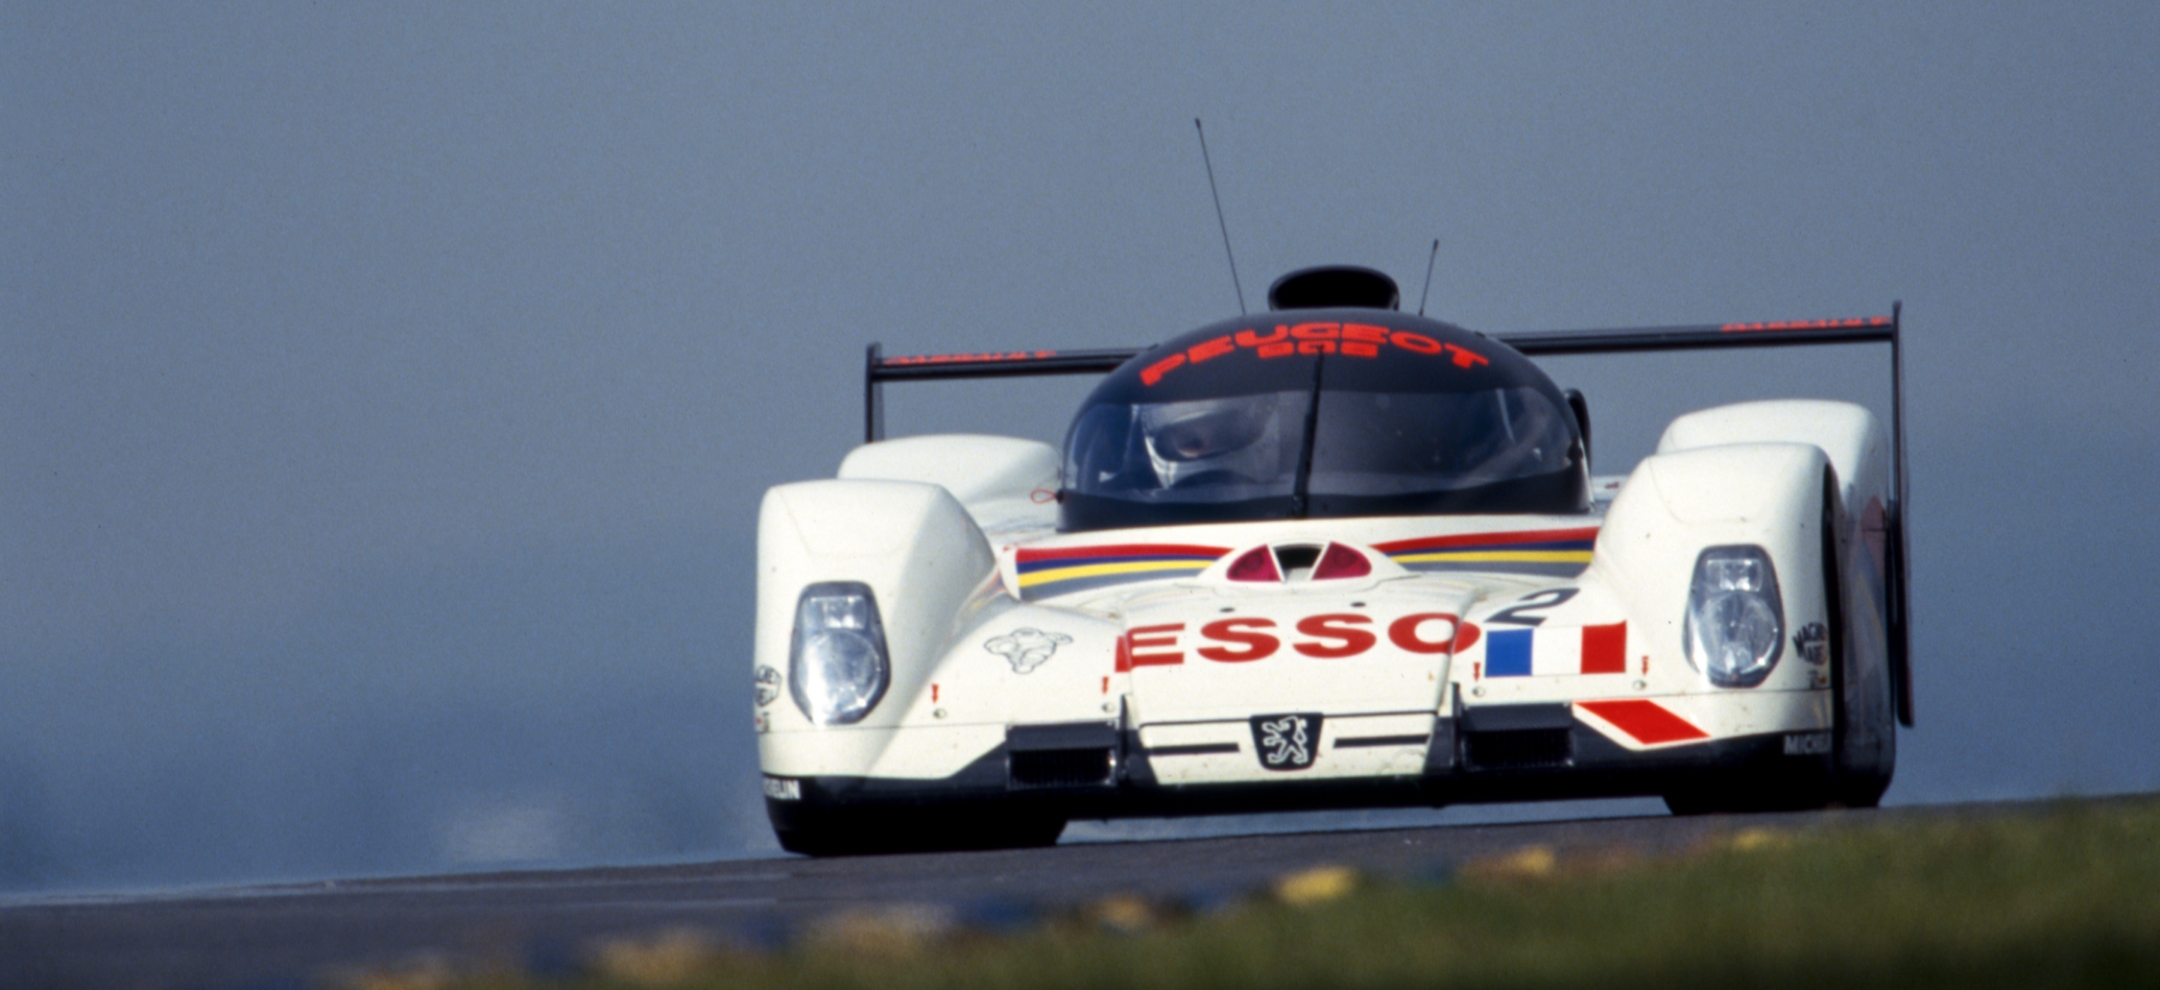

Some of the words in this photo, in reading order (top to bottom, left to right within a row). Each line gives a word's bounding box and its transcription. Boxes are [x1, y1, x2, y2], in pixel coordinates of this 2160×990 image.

[1139, 322, 1489, 386] PEUGEOT
[1484, 588, 1580, 625] 2
[1114, 613, 1481, 673] ESSO
